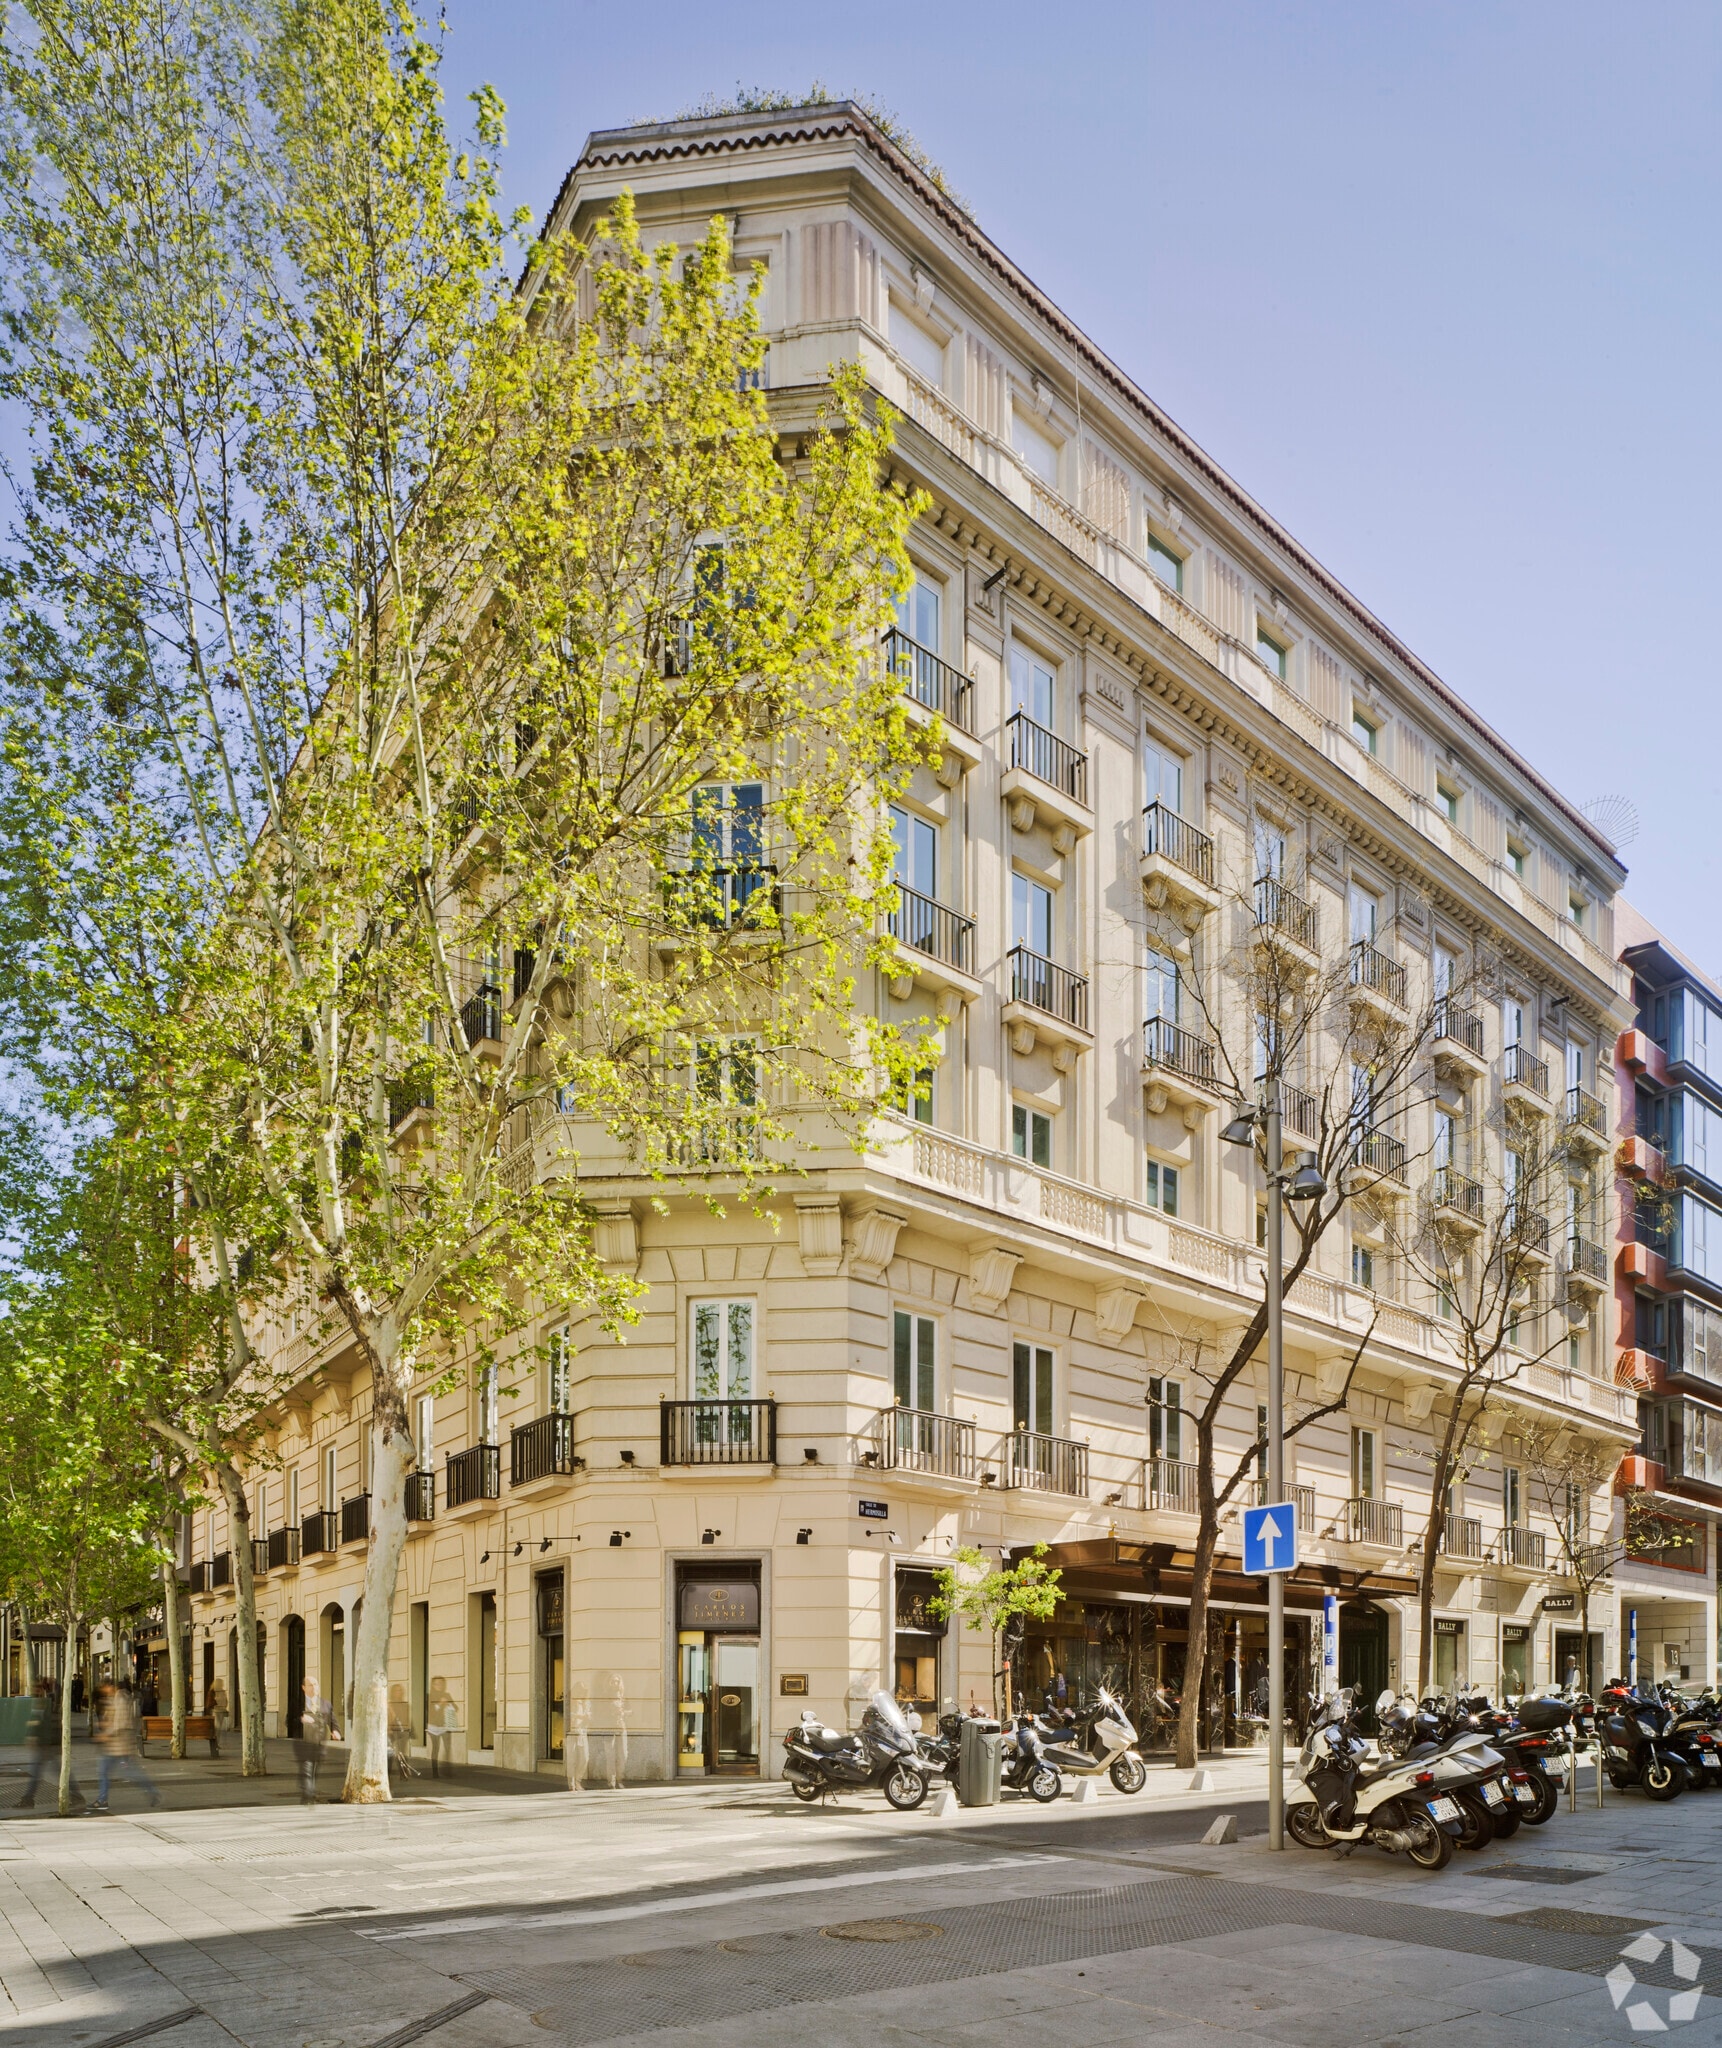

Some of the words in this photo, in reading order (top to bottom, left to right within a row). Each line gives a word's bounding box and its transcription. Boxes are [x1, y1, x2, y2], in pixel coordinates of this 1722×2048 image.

[865, 1508, 886, 1517] HERMOSILLA
[1545, 1599, 1572, 1607] BALLY
[1438, 1622, 1456, 1631] BALLY
[1506, 1628, 1523, 1637] BALLY
[1671, 1650, 1678, 1664] 13
